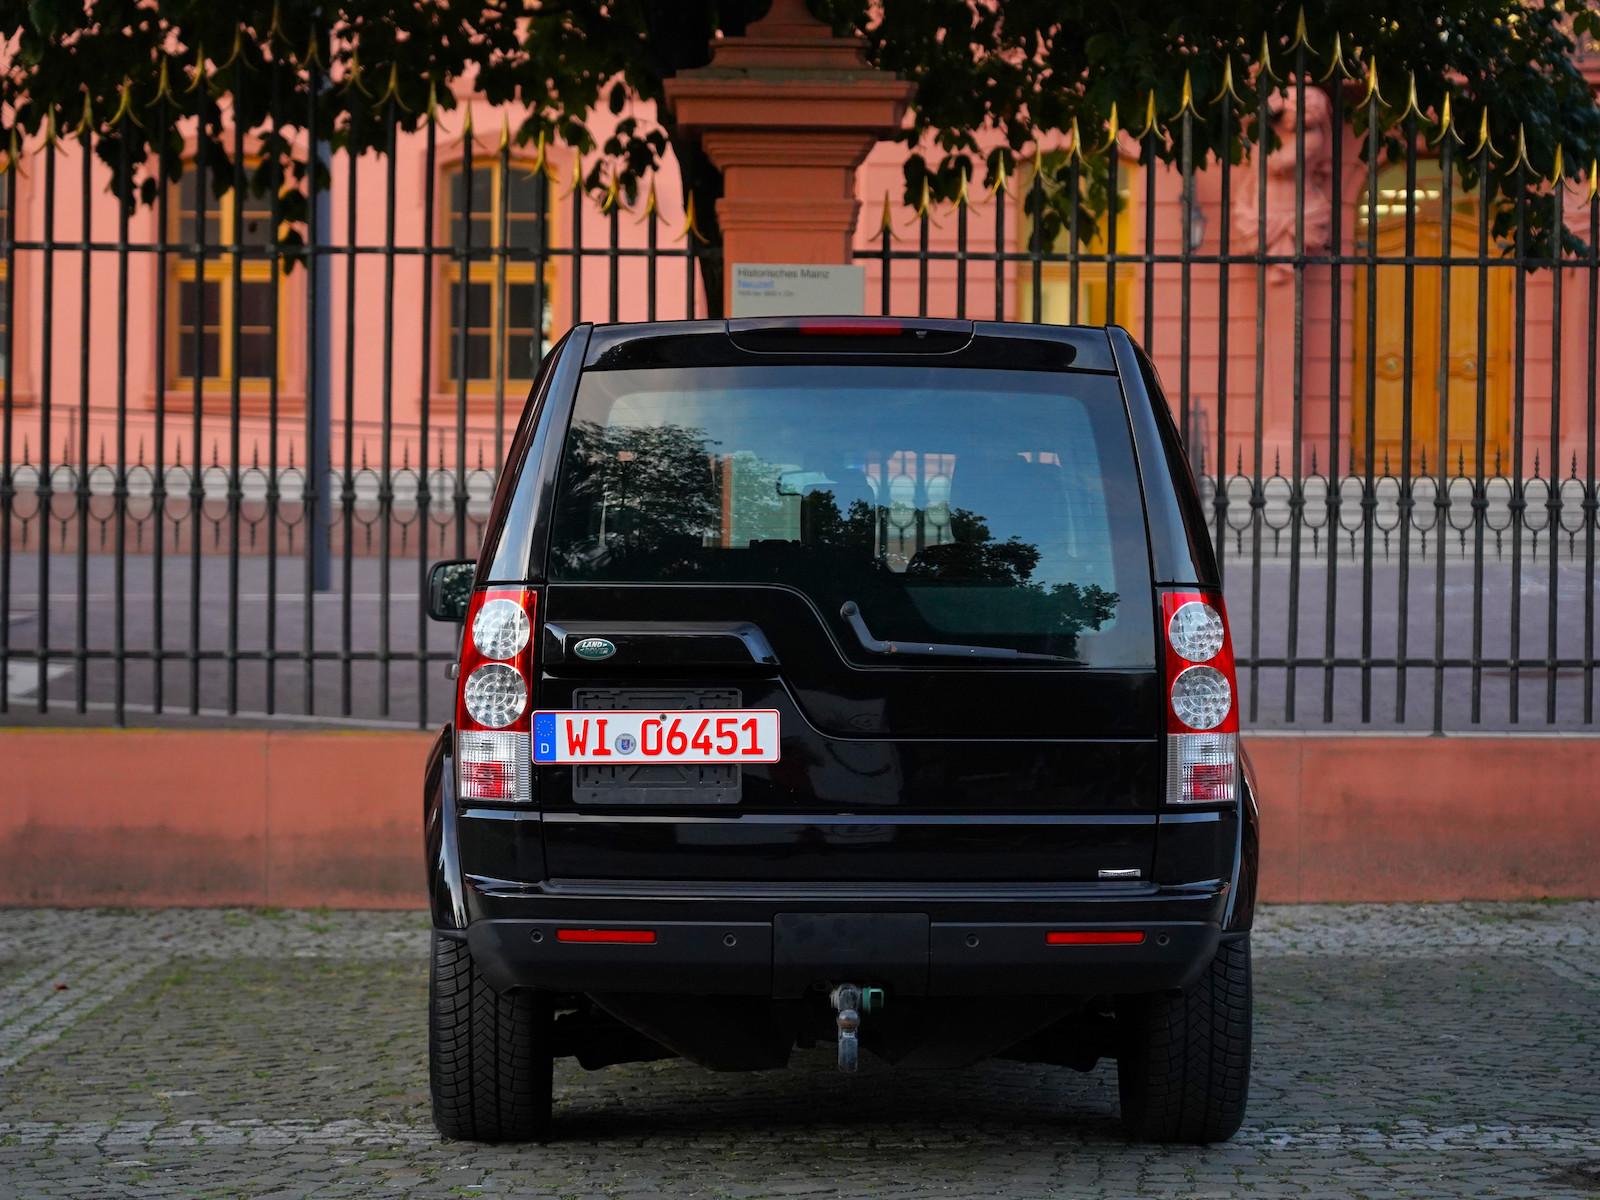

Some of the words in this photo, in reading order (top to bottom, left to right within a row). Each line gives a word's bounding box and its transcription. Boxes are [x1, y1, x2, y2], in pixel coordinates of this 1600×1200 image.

[540, 743, 550, 754] D
[566, 719, 612, 756] WI
[641, 718, 764, 756] 06451
